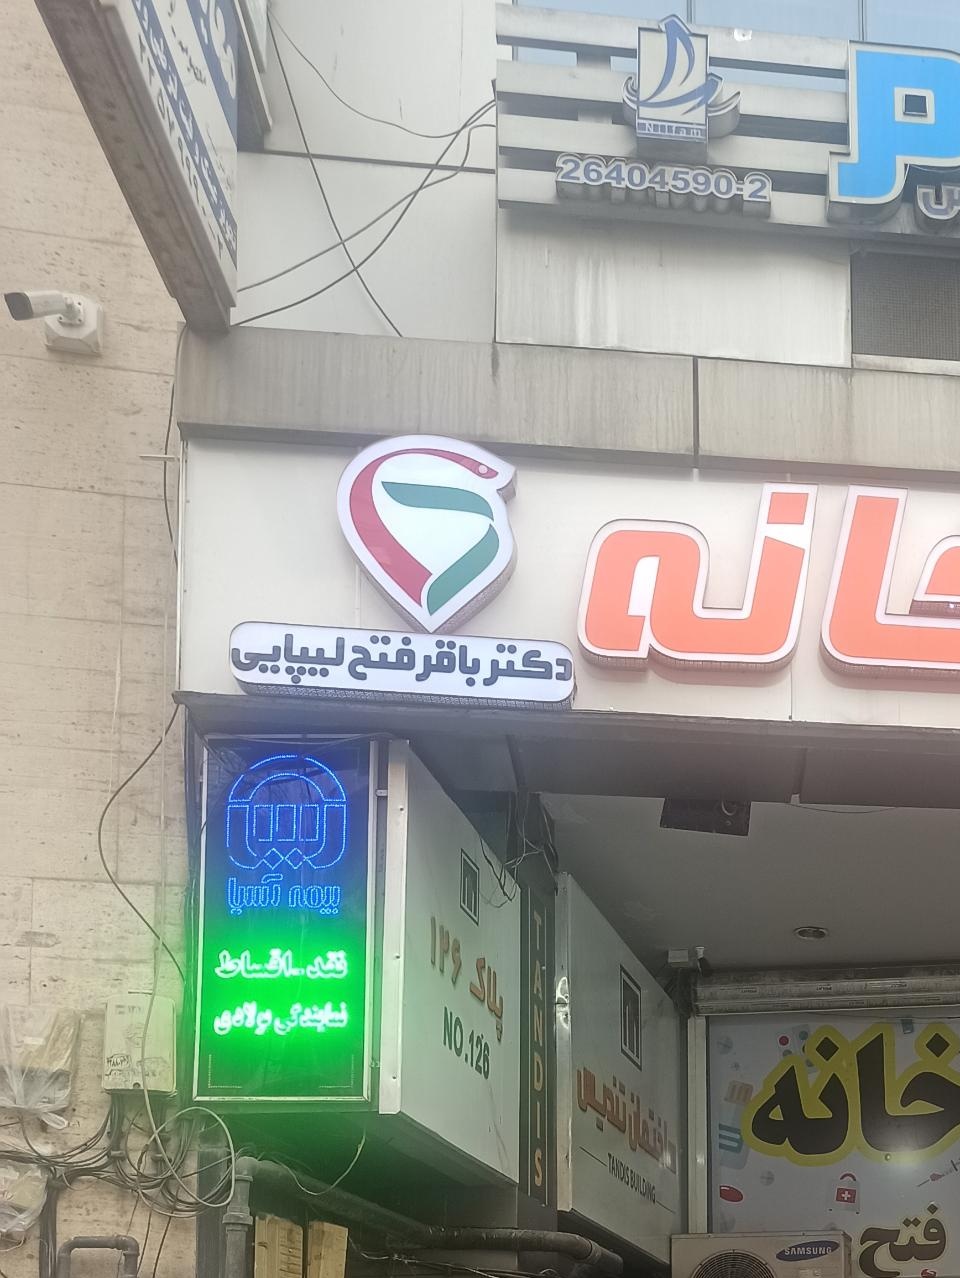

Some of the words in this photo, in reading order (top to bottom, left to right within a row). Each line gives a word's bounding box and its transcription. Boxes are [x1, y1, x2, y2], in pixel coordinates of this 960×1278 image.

[559, 157, 769, 200] 26404590-2
[347, 634, 416, 681] فتح
[414, 638, 481, 687] باقر
[482, 642, 573, 687] دکتر
[227, 873, 284, 915] آسیا
[288, 884, 341, 915] بیمه
[469, 956, 504, 1043] پلاک
[532, 908, 544, 1188] TANDIS
[607, 1151, 629, 1187] TANDIS
[630, 1167, 656, 1205] BUILDING
[784, 1246, 832, 1256] SAMSUNG
[858, 1203, 947, 1278] فتح
